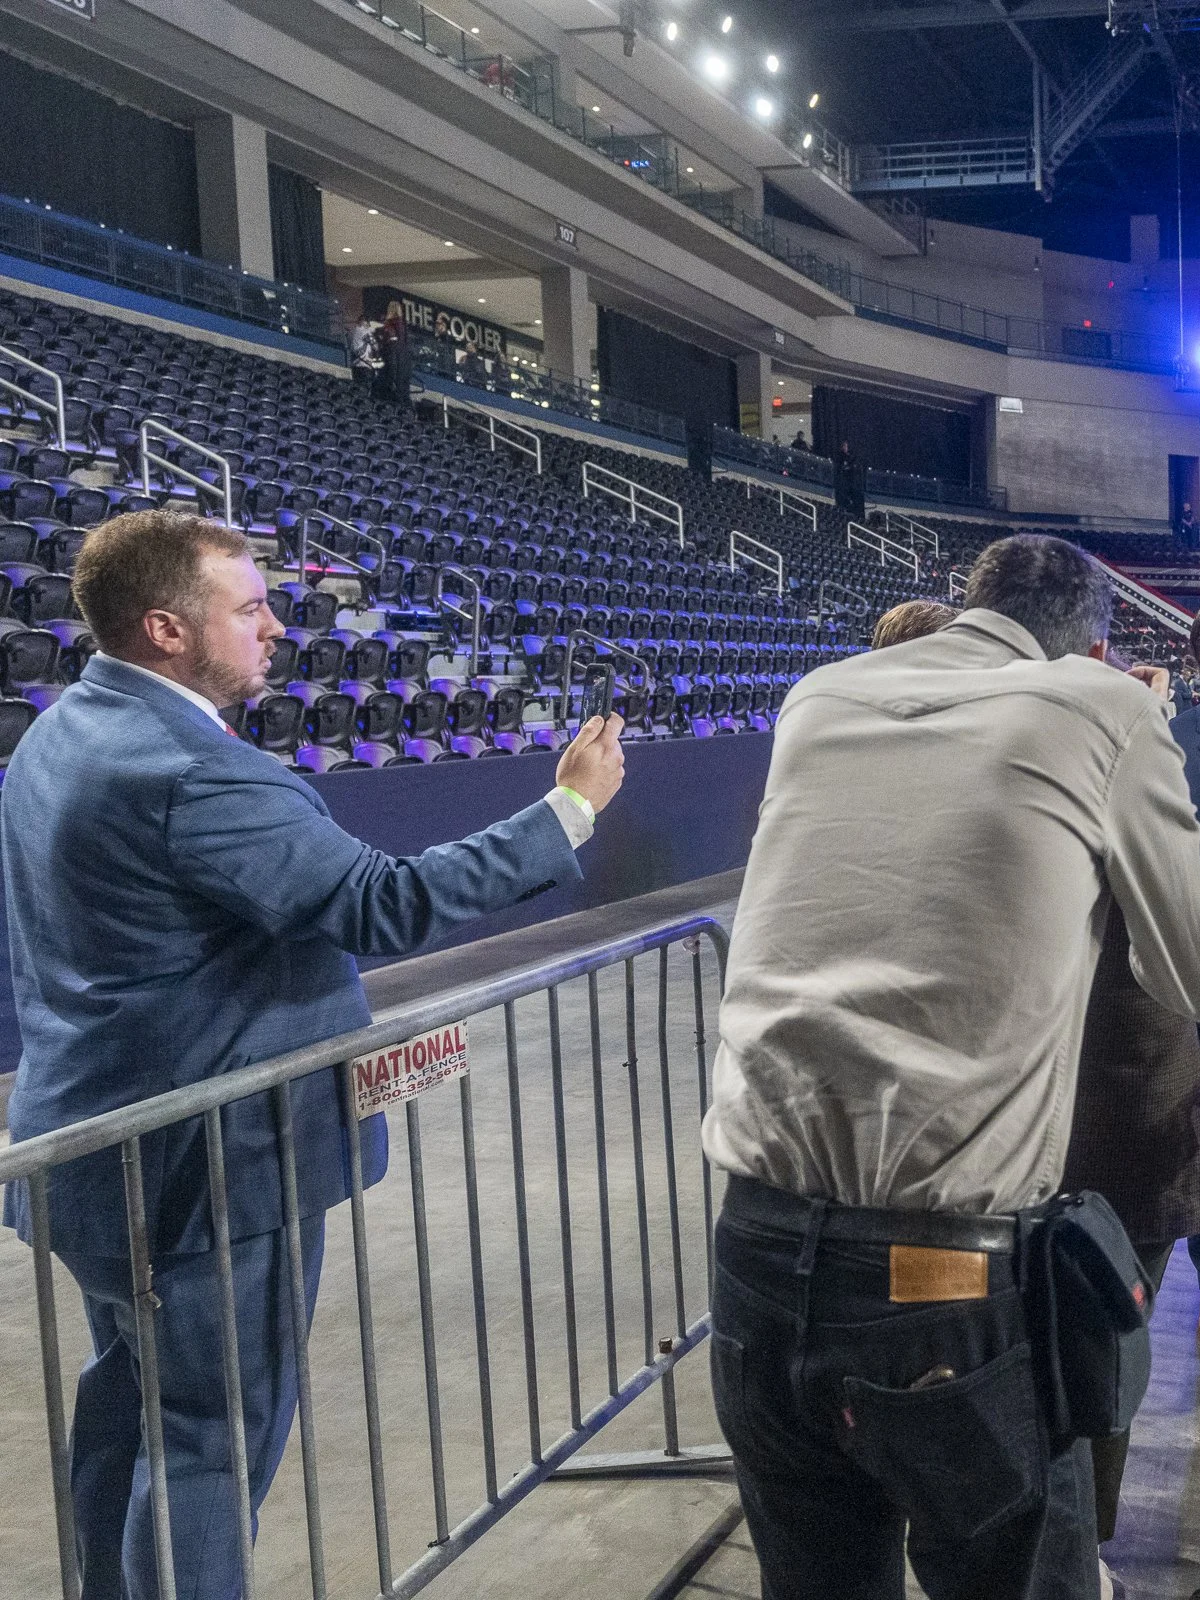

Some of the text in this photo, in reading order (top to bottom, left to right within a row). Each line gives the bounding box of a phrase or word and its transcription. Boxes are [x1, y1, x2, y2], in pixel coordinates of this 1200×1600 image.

[560, 226, 574, 242] 107
[402, 298, 434, 332] THE
[356, 1025, 466, 1092] NATIONAL
[358, 1051, 467, 1102] RENT-A-FENCE
[359, 1060, 467, 1111] 1-800-352-5675
[387, 1078, 444, 1105] rentnational.com
